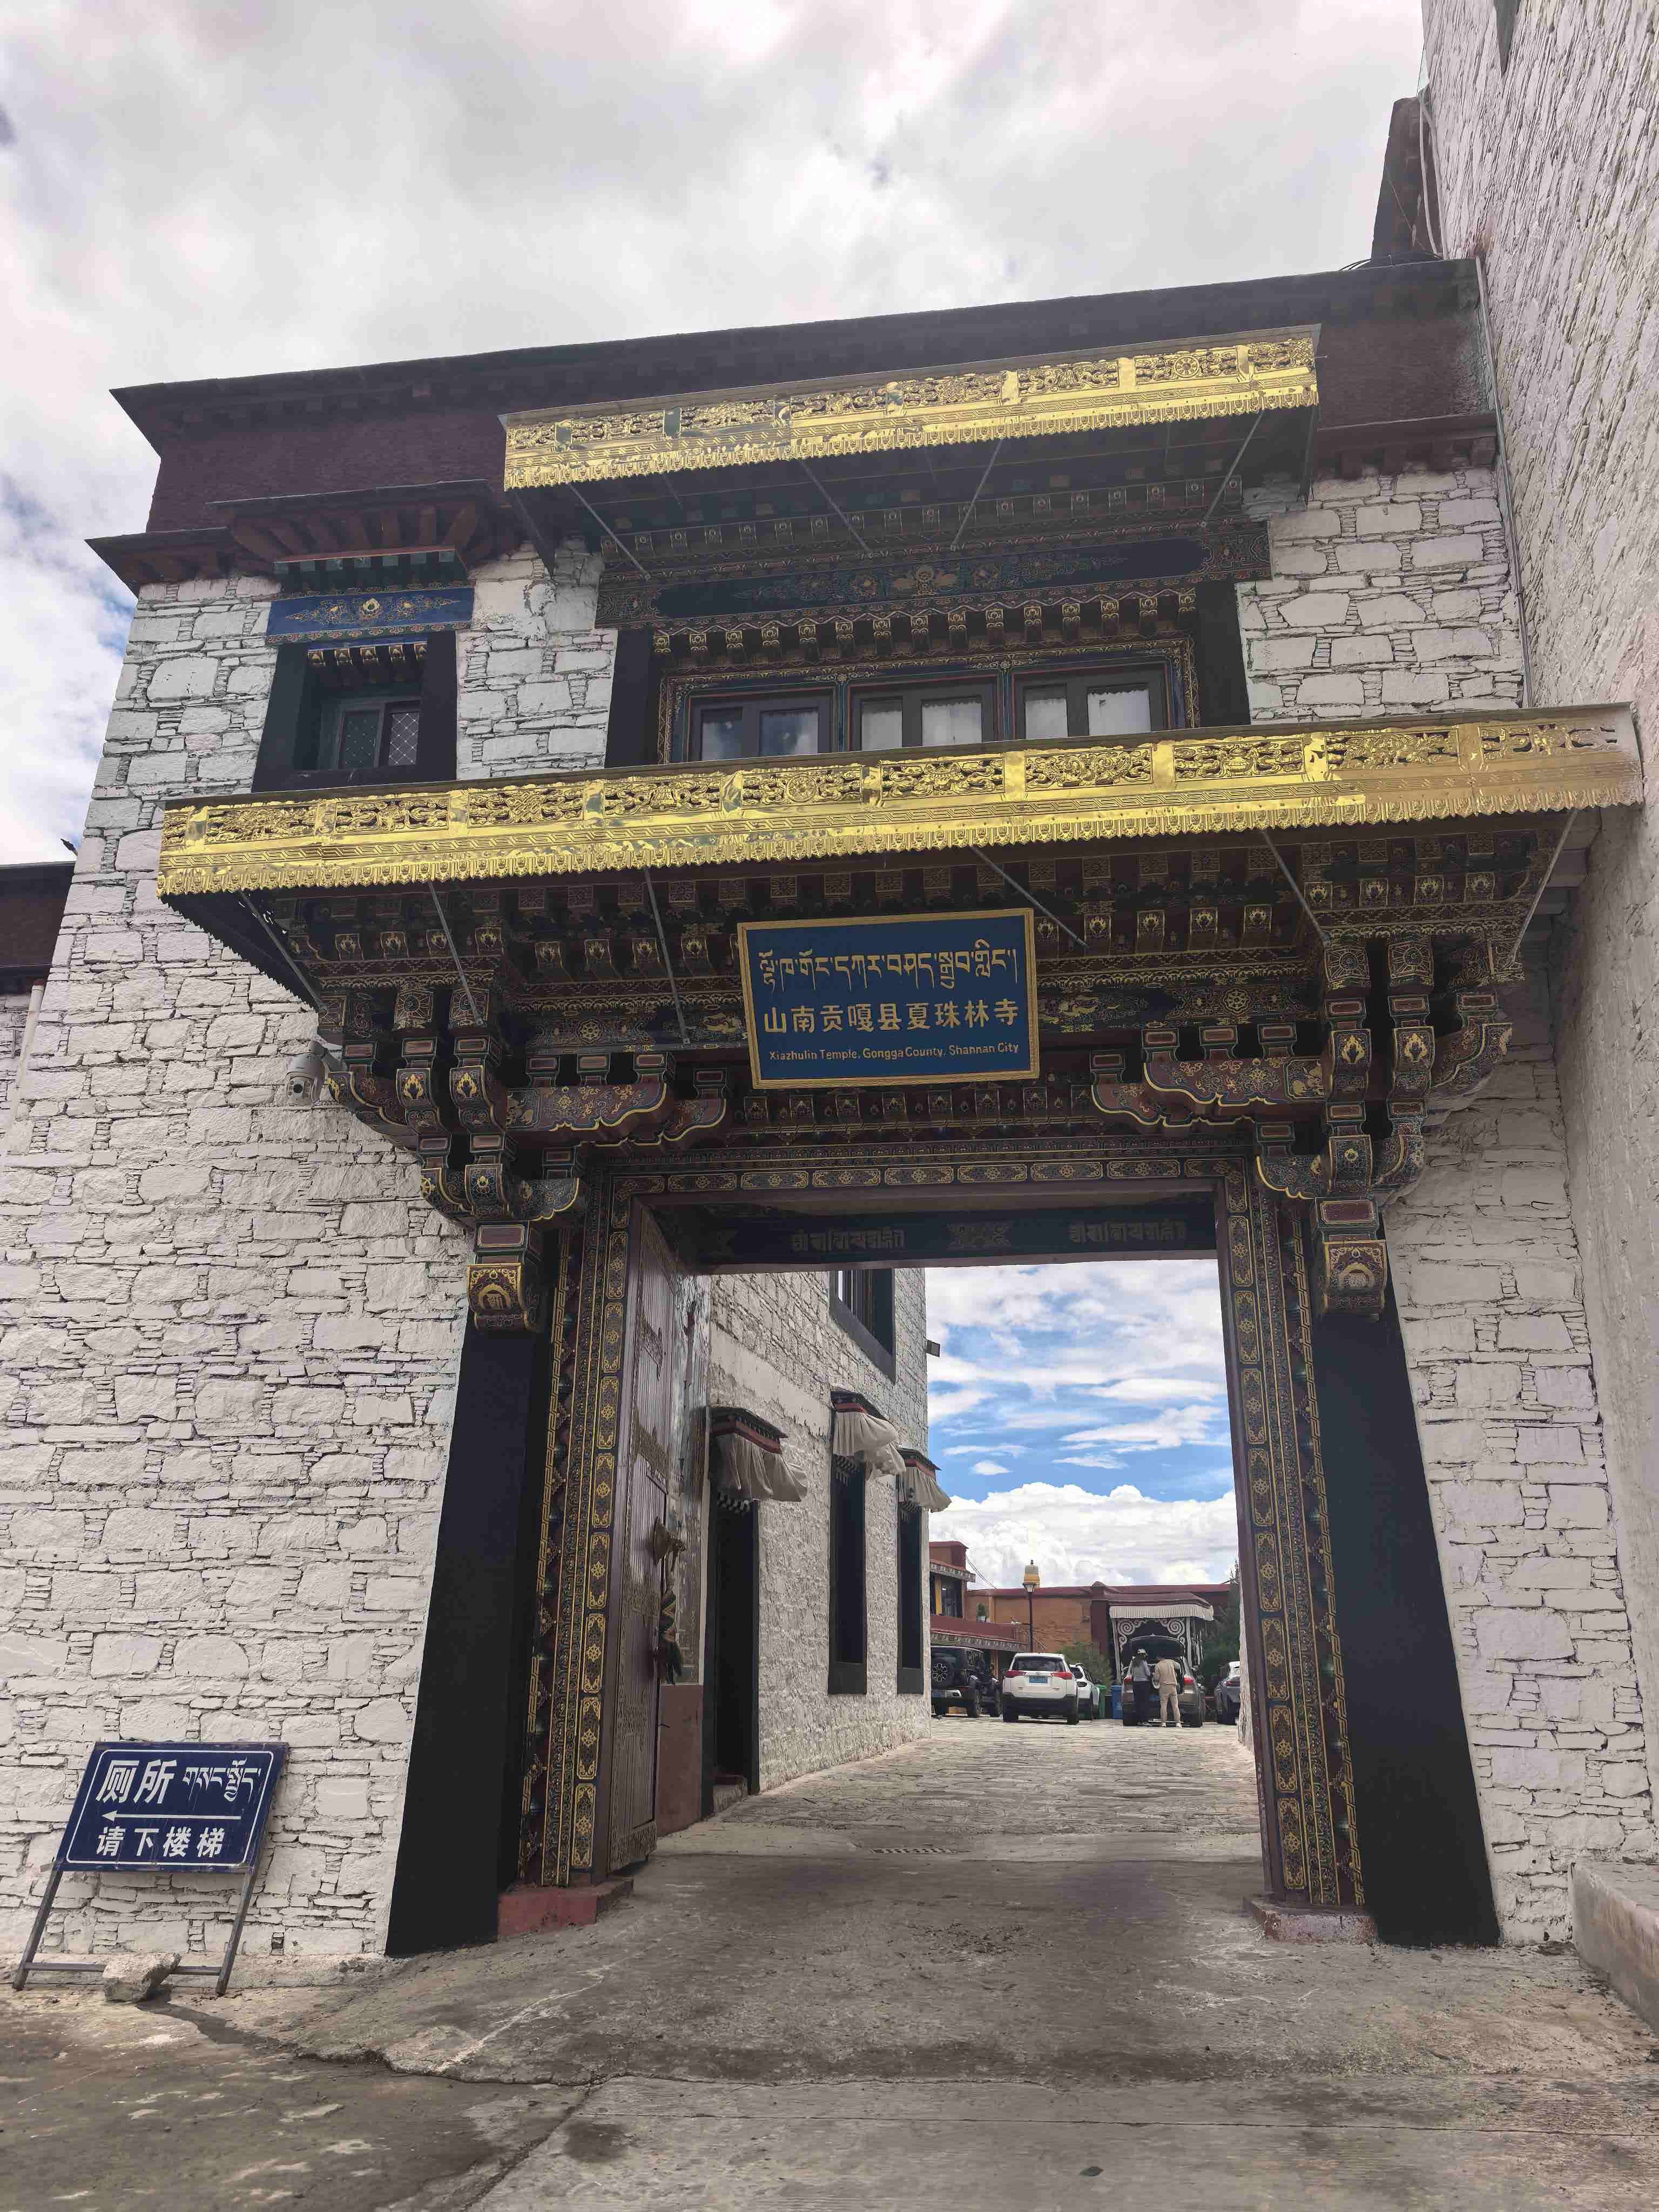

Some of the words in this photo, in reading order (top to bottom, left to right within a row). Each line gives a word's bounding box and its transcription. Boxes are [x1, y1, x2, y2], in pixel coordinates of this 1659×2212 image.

[763, 997, 1019, 1033] 山南贡嘎县夏珠林寺
[769, 1049, 817, 1061] Xiazhulin
[862, 1047, 903, 1060] Gongga
[949, 1044, 995, 1056] Shannan
[997, 1041, 1019, 1054] City
[96, 1759, 177, 1804] 厕所
[95, 1826, 225, 1858] 请下楼梯
